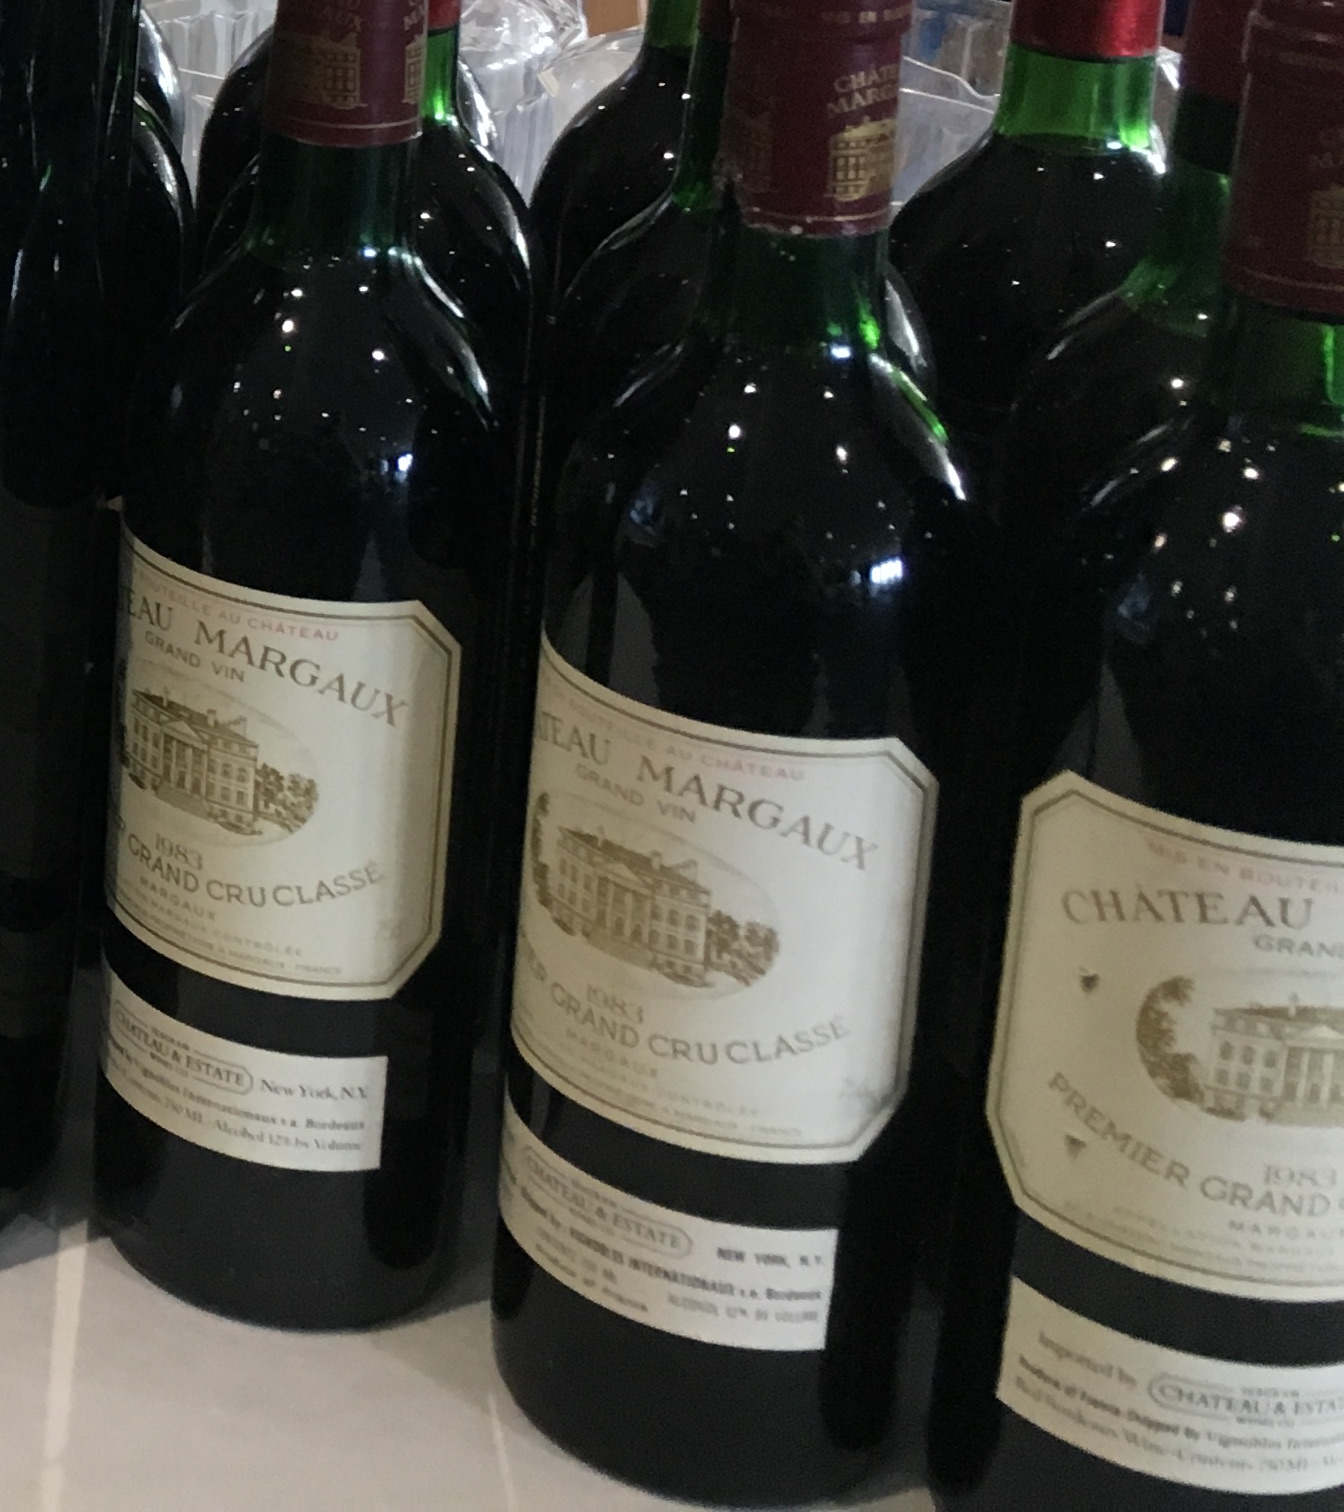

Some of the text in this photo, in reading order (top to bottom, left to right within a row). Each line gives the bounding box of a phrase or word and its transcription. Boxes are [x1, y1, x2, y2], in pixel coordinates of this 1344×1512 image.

[144, 630, 246, 683] GRAND VIN
[193, 620, 409, 728] MARGAUX
[575, 762, 697, 823] GRAND VIN
[636, 754, 879, 872] MARGAUX
[127, 833, 200, 894] GRAND
[206, 879, 267, 908] CRU
[155, 833, 204, 872] 1983
[549, 981, 719, 1066] GRAND CRU
[185, 1053, 295, 1097] ESTATE New
[1047, 1072, 1331, 1217] PREMIER GRAND
[612, 1211, 681, 1249] ESTATE
